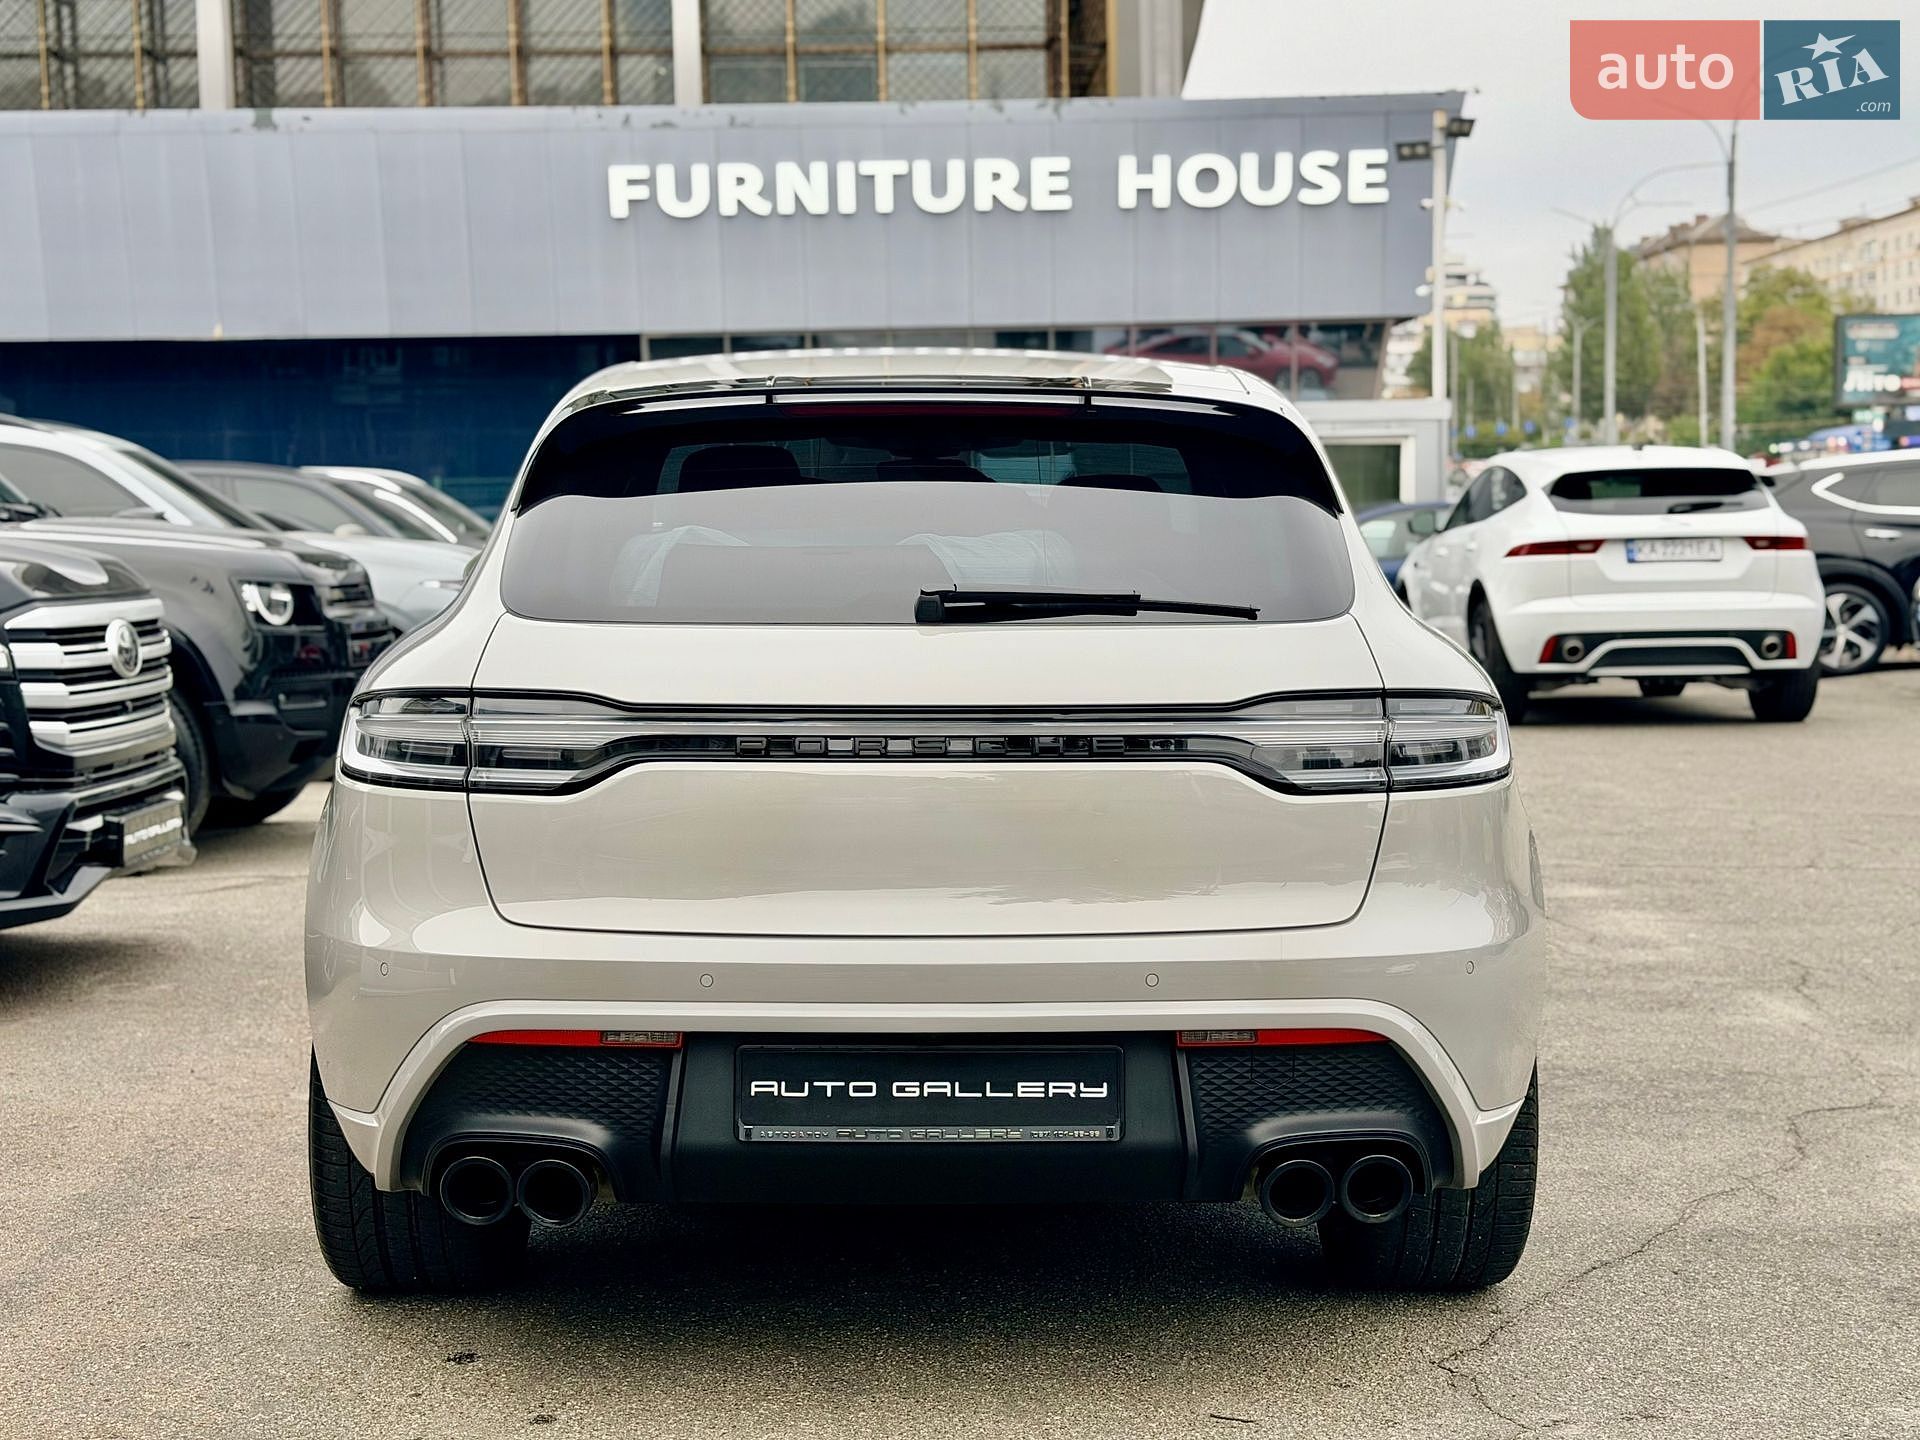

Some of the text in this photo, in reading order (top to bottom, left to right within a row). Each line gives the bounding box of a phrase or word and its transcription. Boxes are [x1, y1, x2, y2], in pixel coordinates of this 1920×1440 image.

[607, 147, 1391, 219] FURNITURE HOUSE
[735, 736, 1125, 756] PORSCHE
[750, 1081, 1108, 1098] AUTO GALLERY
